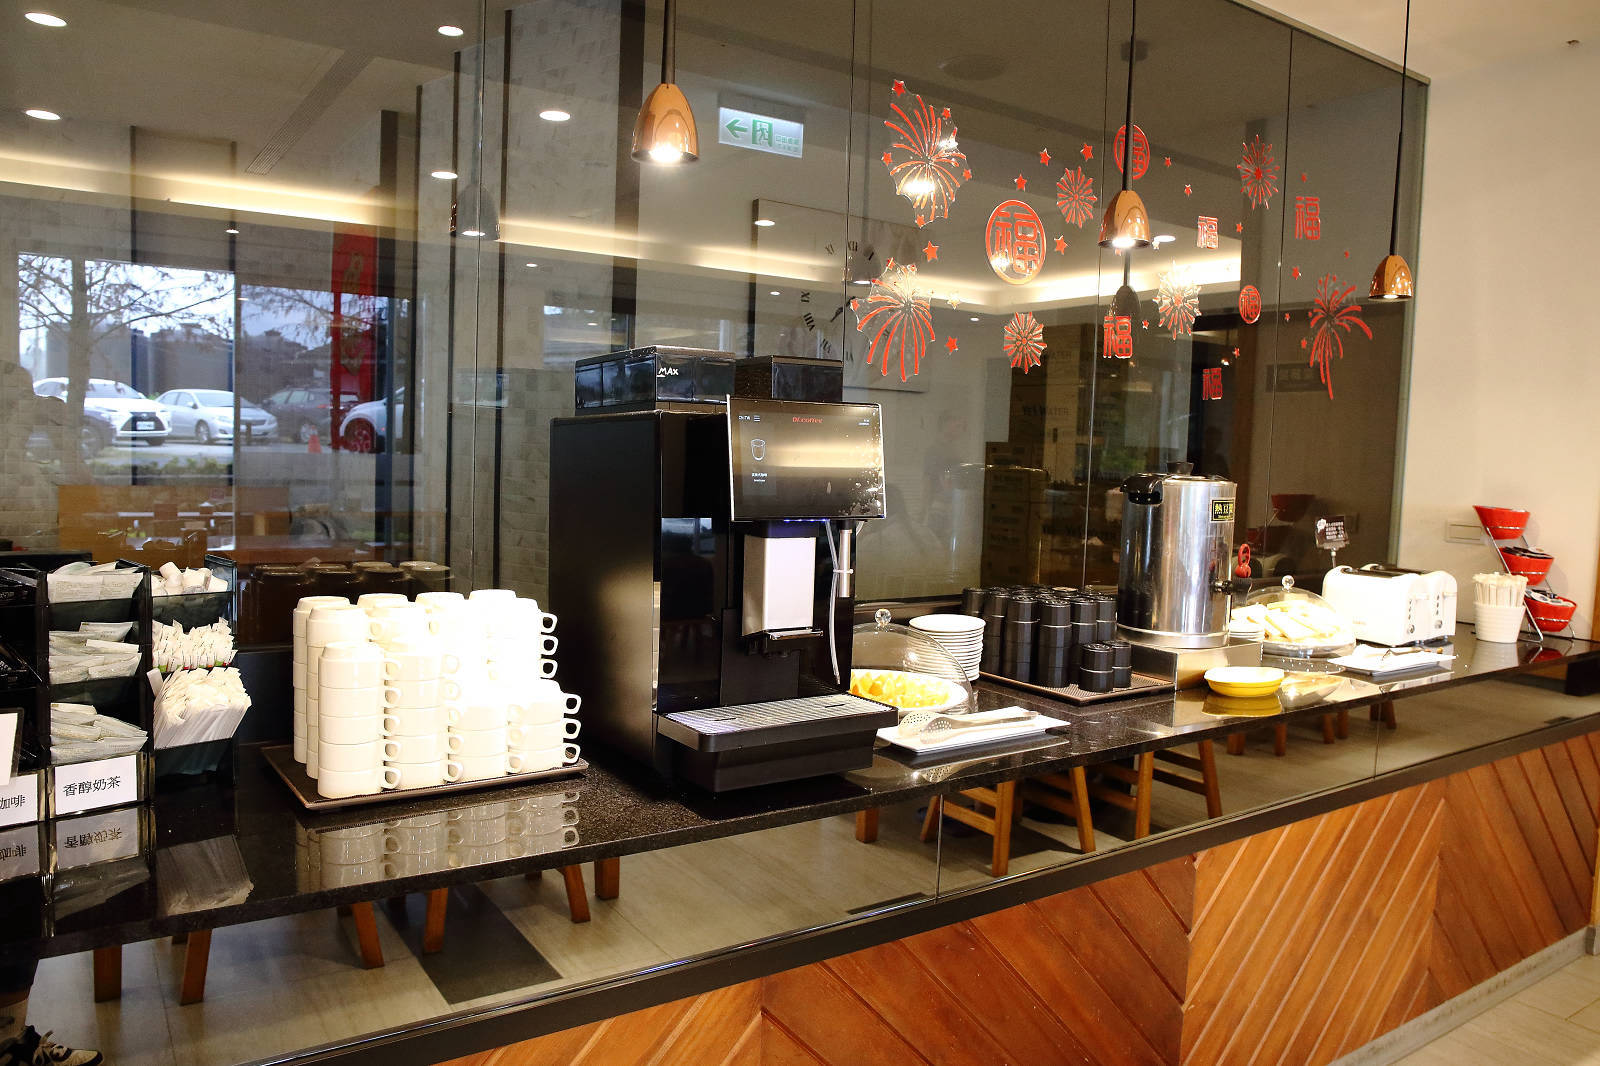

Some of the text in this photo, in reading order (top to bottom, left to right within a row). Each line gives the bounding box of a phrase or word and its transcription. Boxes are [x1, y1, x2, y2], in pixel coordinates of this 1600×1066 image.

[1117, 132, 1146, 174] 福
[1198, 215, 1218, 249] 福
[1295, 196, 1321, 240] 福
[993, 208, 1040, 276] 福
[1240, 288, 1260, 321] 福
[1103, 315, 1133, 359] 福
[658, 367, 679, 376] MAX
[1202, 367, 1223, 400] 福
[63, 775, 121, 797] 香醇奶茶
